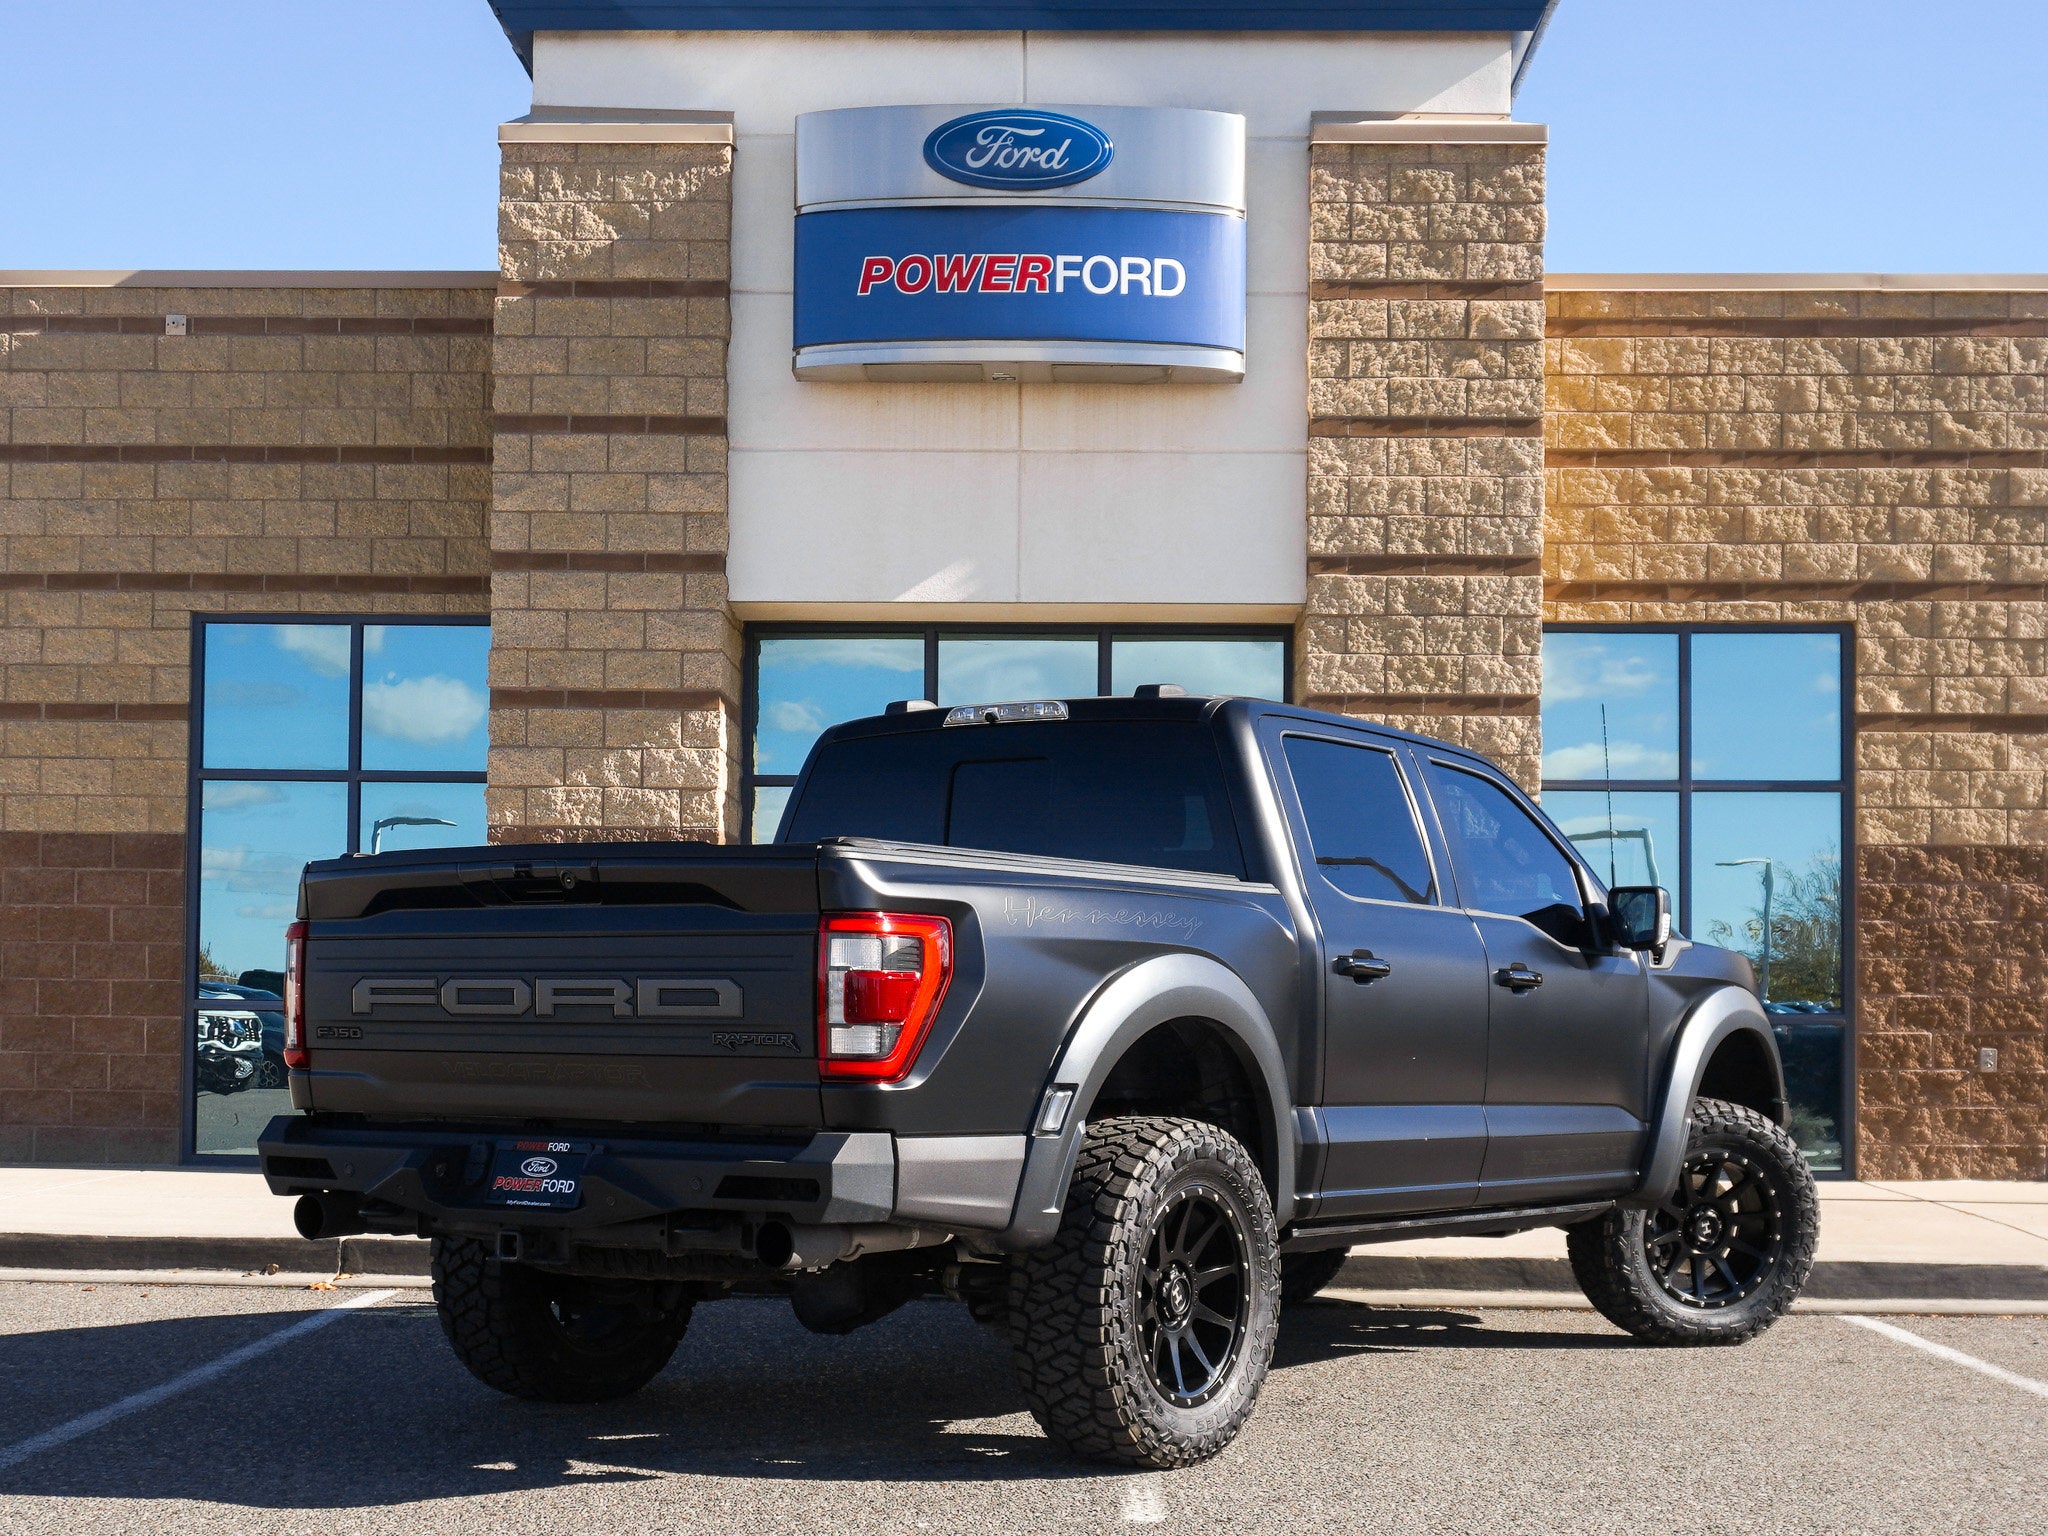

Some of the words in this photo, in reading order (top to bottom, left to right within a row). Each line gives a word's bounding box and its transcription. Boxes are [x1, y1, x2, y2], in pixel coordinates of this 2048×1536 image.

[965, 125, 1072, 170] Ford
[857, 253, 1187, 297] POWERFORD
[1003, 896, 1203, 940] Hennessey
[351, 975, 745, 1019] FORD
[316, 1026, 362, 1039] F-150
[711, 1032, 801, 1053] RAPTOR
[527, 1160, 550, 1173] Ford
[493, 1176, 575, 1193] POWERFORD
